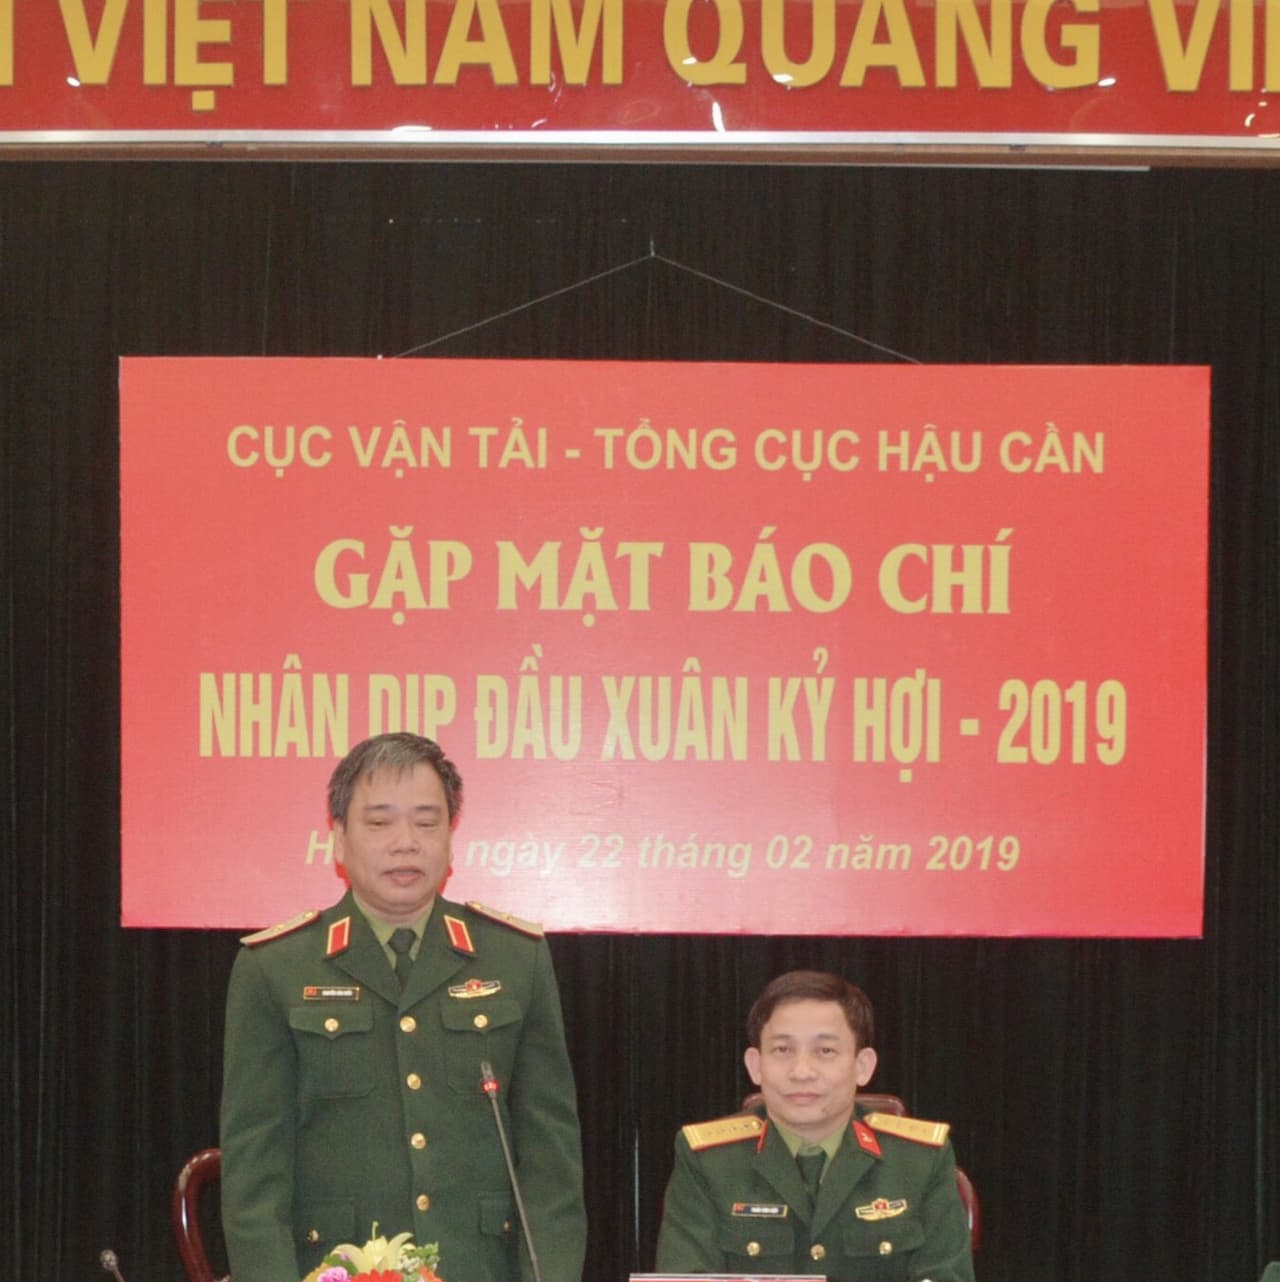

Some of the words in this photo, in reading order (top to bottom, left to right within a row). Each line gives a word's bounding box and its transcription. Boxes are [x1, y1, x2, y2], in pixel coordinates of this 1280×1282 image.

[663, 0, 1102, 89] QUANG
[227, 426, 333, 479] CỤC
[349, 420, 453, 480] VẬN
[469, 417, 549, 470] TẢI
[594, 418, 738, 472] TỔNG
[755, 429, 861, 483] CỤC
[879, 424, 983, 484] HẬU
[1000, 422, 1105, 475] CẦN
[315, 526, 474, 627] GẶP
[496, 527, 666, 628] MẶT
[688, 526, 854, 615] BÁO
[879, 528, 1013, 615] CHÍ
[200, 654, 351, 760] NHÂN
[474, 644, 584, 761] ĐẦU
[602, 657, 750, 763] XUÂN
[768, 647, 837, 764] KỶ
[853, 669, 942, 785] HỢI
[997, 678, 1128, 766] 2019
[465, 832, 568, 877] ngày
[576, 834, 626, 868] 22
[638, 833, 754, 878] tháng
[766, 835, 814, 870] 02
[824, 835, 913, 871] năm
[926, 835, 1020, 872] 2019
